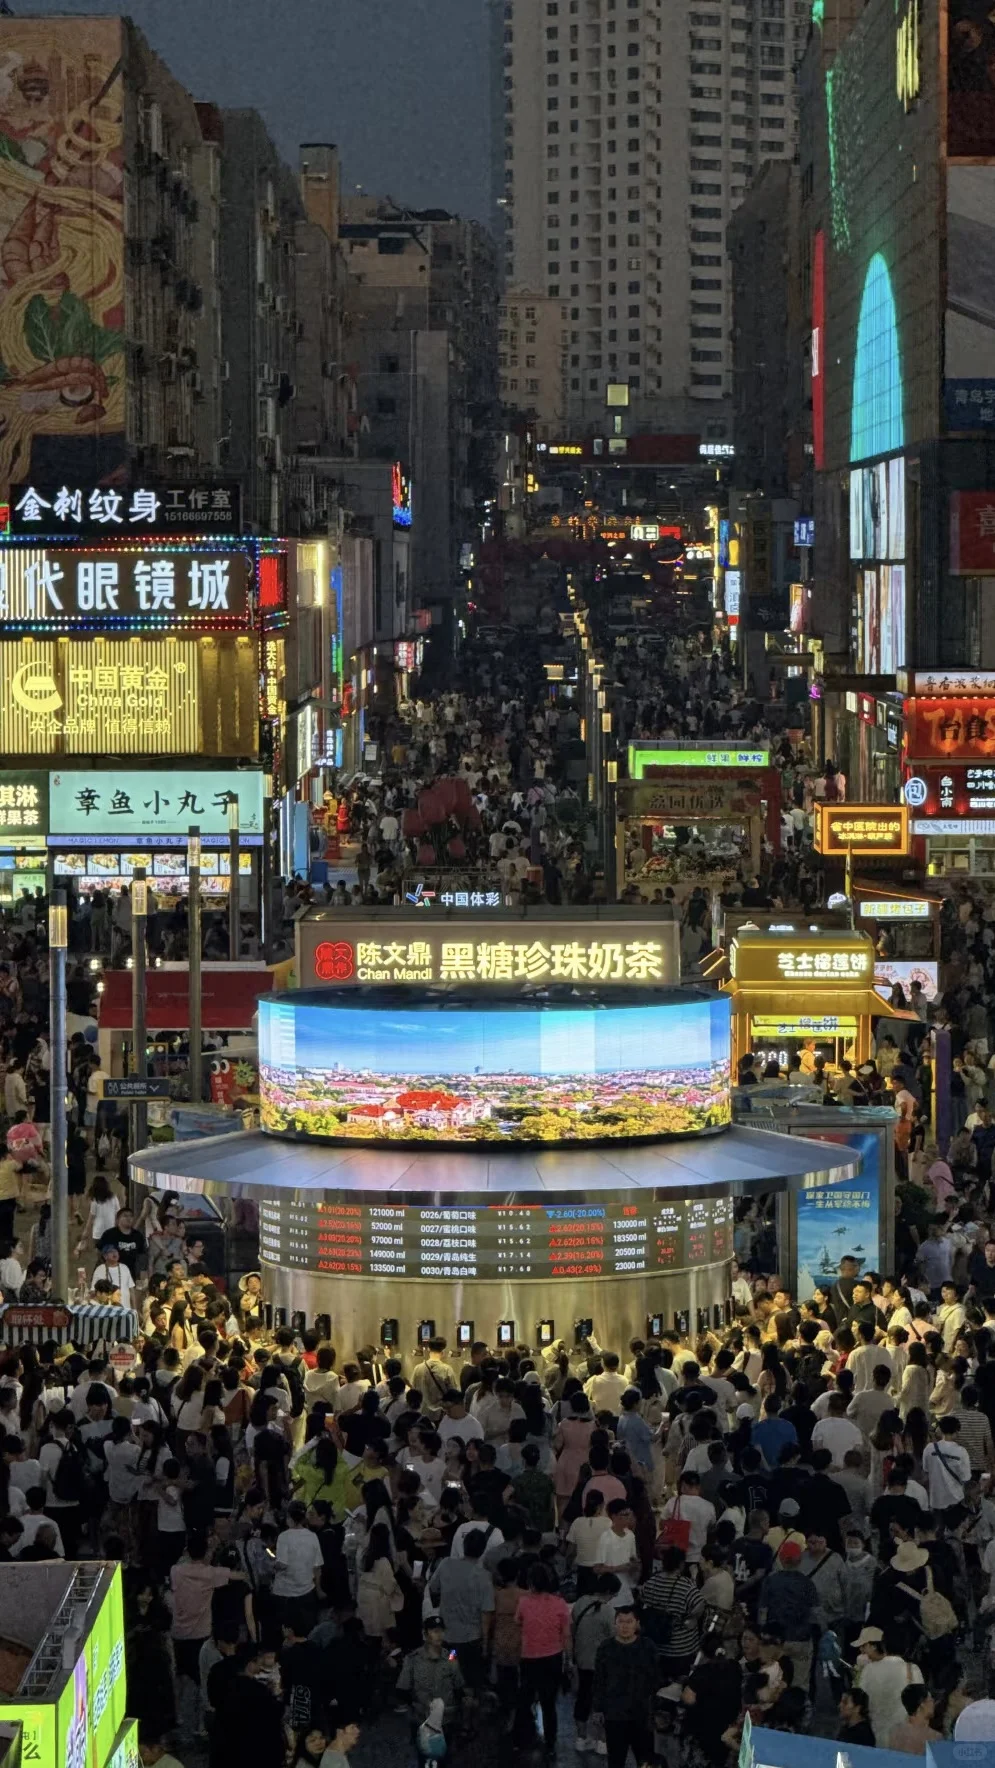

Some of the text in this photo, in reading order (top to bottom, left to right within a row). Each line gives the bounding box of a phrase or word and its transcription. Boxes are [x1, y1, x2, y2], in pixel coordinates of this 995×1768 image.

[15, 486, 161, 523] 金刺纹身
[165, 489, 232, 509] 工作室
[0, 560, 229, 610] 代眼镜城
[69, 666, 170, 690] 中国黄金
[77, 694, 163, 707] China Gold
[30, 719, 172, 735] 央企品牌 值得信赖
[74, 787, 238, 816] 章鱼小丸子
[136, 837, 183, 845] 章鱼小丸子
[441, 892, 500, 906] 中国体彩
[863, 903, 926, 915] 新疆烤包子
[357, 942, 432, 965] 陈文鼎
[440, 941, 662, 980] 黑糖珍珠奶茶
[778, 953, 868, 971] 芝士榴莲饼
[358, 968, 390, 980] Chan
[369, 1208, 405, 1217] 121000 ml
[371, 1222, 403, 1231] 52000 ml
[613, 1219, 647, 1228] 130000 ml
[371, 1236, 403, 1245] 97000 ml
[420, 1239, 476, 1248] 0028/荔枝口味
[613, 1233, 647, 1243] 183500 ml
[370, 1250, 405, 1259] 149000 ml
[420, 1253, 476, 1262] 0029/青岛纯生
[615, 1247, 645, 1257] 20500 ml
[370, 1264, 405, 1273] 133500 ml
[615, 1261, 645, 1271] 23000 ml
